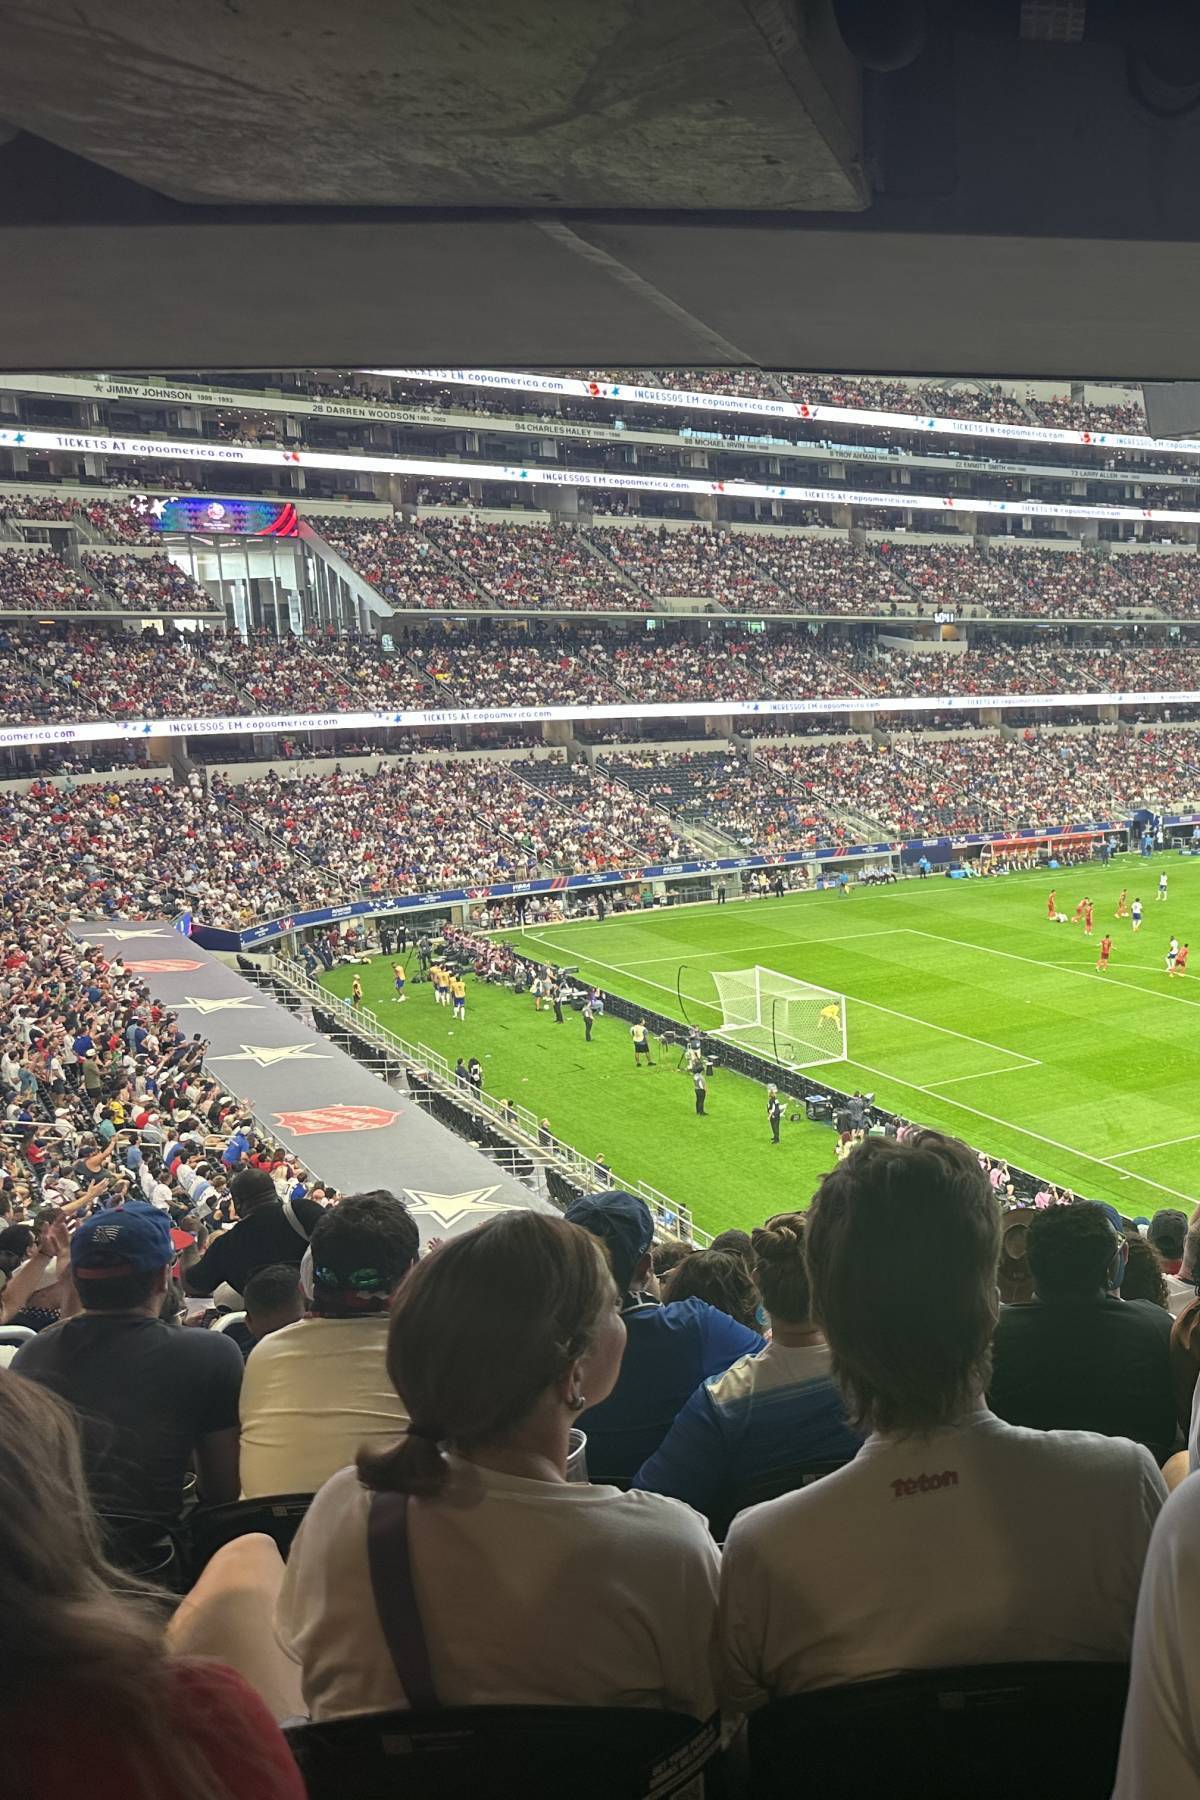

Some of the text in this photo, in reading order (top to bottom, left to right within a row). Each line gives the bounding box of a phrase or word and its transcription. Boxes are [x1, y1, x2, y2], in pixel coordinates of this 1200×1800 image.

[106, 385, 139, 395] JIMMY
[142, 388, 192, 400] JOHNSON
[634, 389, 682, 402] INGRESSOS
[686, 396, 699, 404] EM
[326, 406, 365, 416] DARREN
[368, 409, 416, 420] WOODSON
[527, 424, 564, 434] CHARLES
[566, 427, 591, 436] HALEY
[56, 437, 107, 450] TICKETS
[112, 441, 126, 450] AT
[695, 438, 725, 448] MICHAEL
[542, 472, 590, 483] INGRESSOS
[594, 476, 606, 484] EM
[423, 713, 457, 722] TICKETS
[461, 712, 470, 720] AT
[169, 722, 224, 732] INGRESSOS
[228, 721, 242, 730] EM
